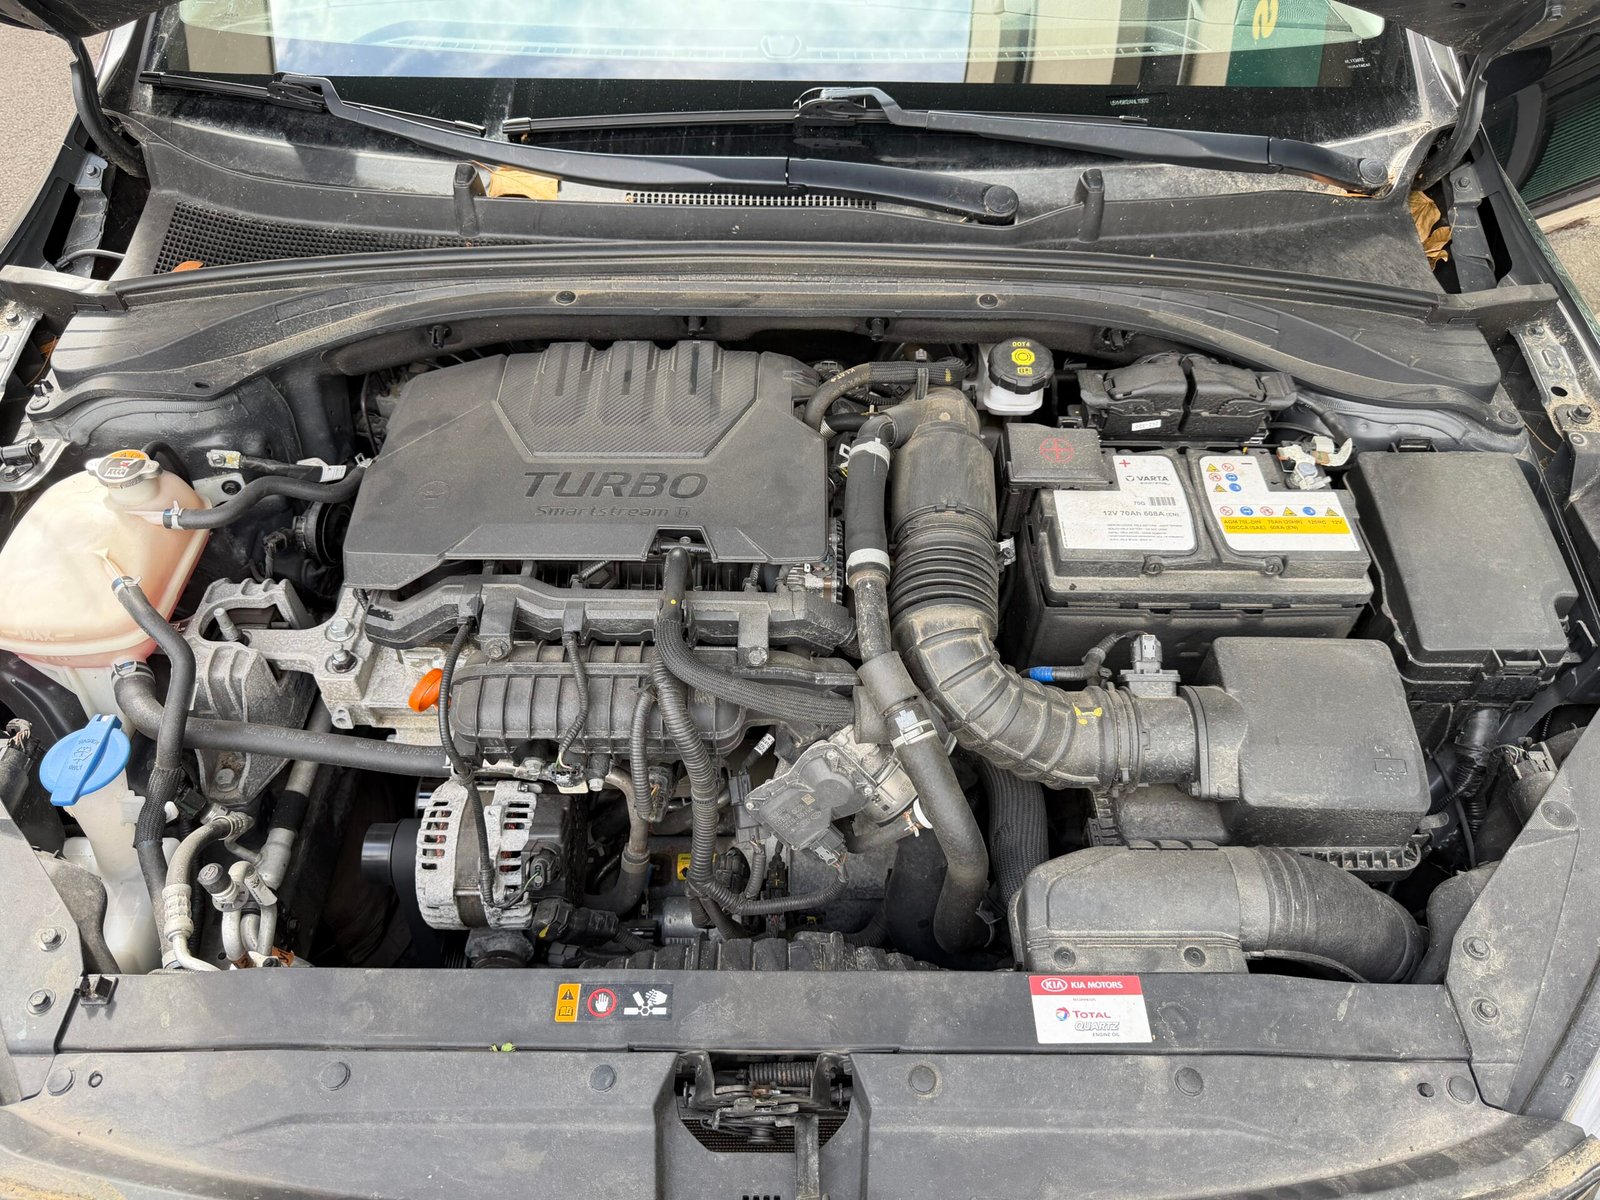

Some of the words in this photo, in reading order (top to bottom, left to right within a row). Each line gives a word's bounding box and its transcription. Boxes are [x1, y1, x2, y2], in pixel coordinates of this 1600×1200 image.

[524, 471, 708, 498] TURBO
[535, 505, 669, 517] Smartstream
[1045, 980, 1064, 989] KIA
[1070, 981, 1086, 989] KIA
[1087, 981, 1123, 989] MOTORS
[1072, 1010, 1111, 1019] TOTAL
[1075, 1021, 1120, 1031] QUARTZ
